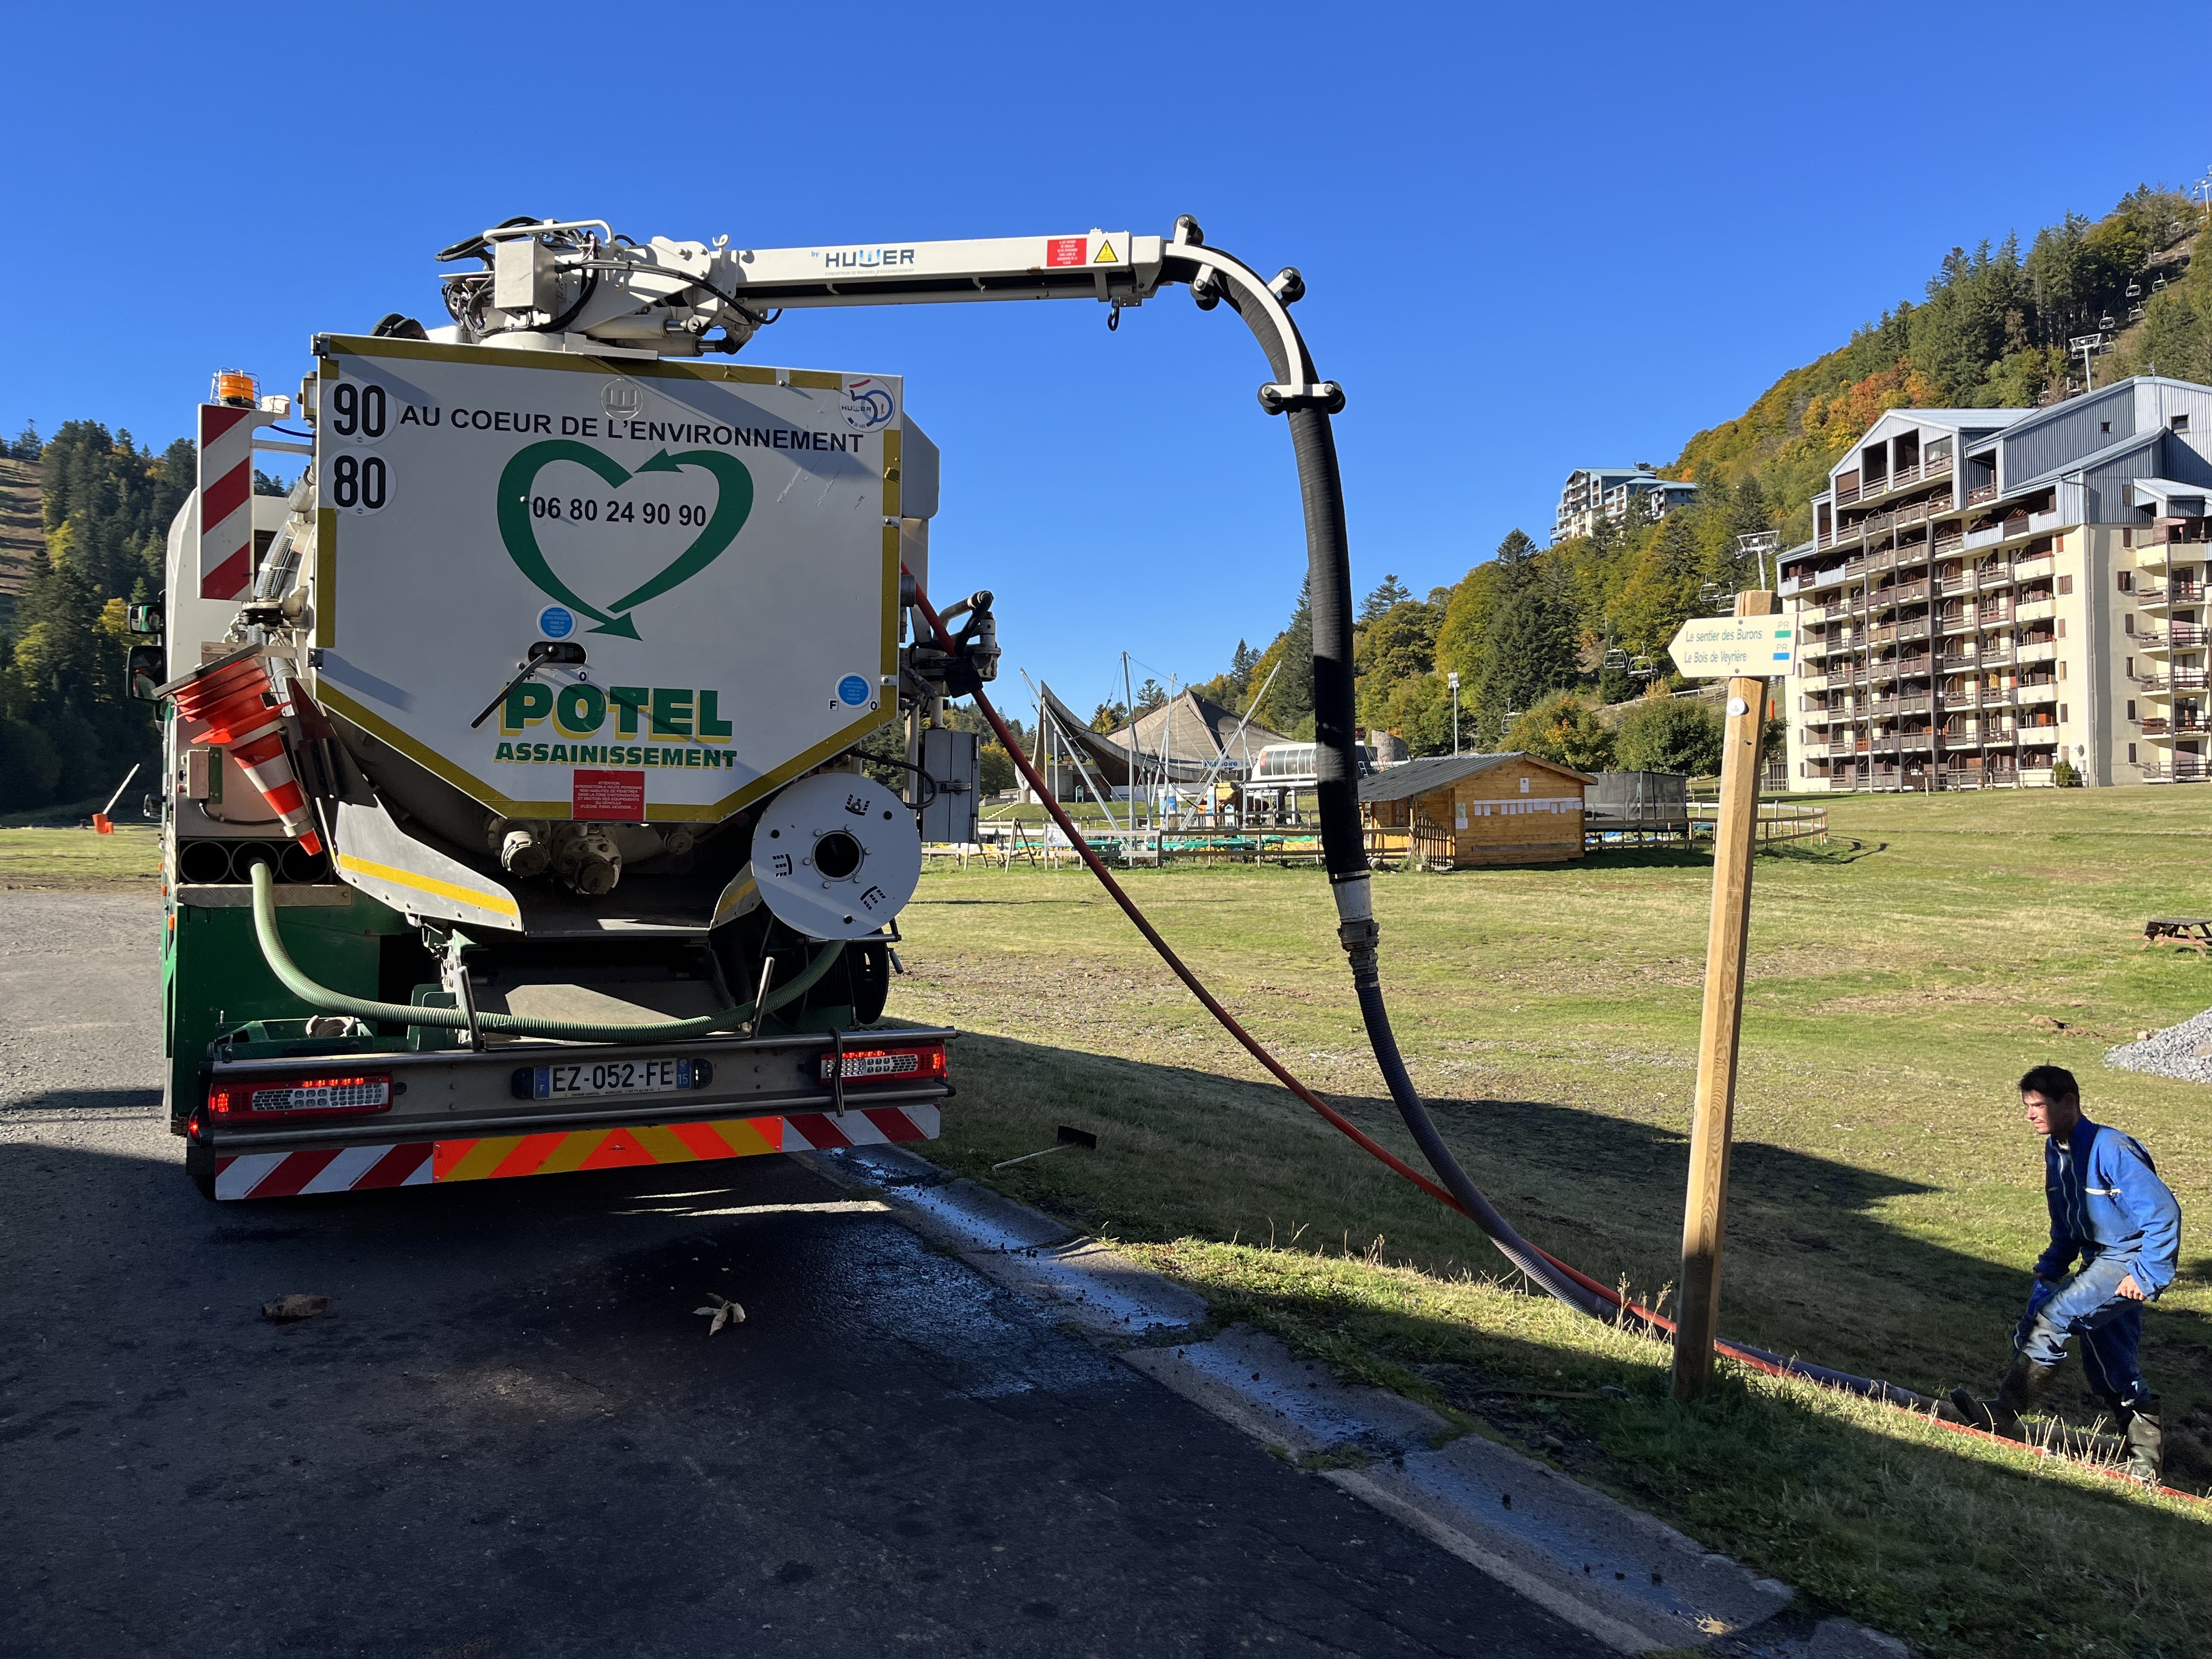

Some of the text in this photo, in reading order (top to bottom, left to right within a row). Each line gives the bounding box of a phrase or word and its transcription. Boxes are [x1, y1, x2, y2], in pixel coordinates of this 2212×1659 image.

[826, 249, 915, 267] HUWER
[333, 383, 387, 437] 90
[400, 405, 864, 453] AU COEUR DE L'ENVIRONNEMENT
[333, 455, 387, 509] 80
[533, 496, 707, 527] 06 80 24 90 90
[1686, 628, 1763, 642] Le sentier des Burons
[1778, 621, 1790, 629] PR
[1684, 652, 1692, 663] Le
[1694, 652, 1708, 663] Bois
[1710, 651, 1718, 662] de
[1776, 644, 1787, 652] PR
[499, 682, 733, 744] POTEL
[830, 701, 837, 709] F
[494, 742, 737, 770] ASSAINISSEMENT
[552, 1061, 673, 1091] EZ-052-FE
[678, 1074, 689, 1085] 15
